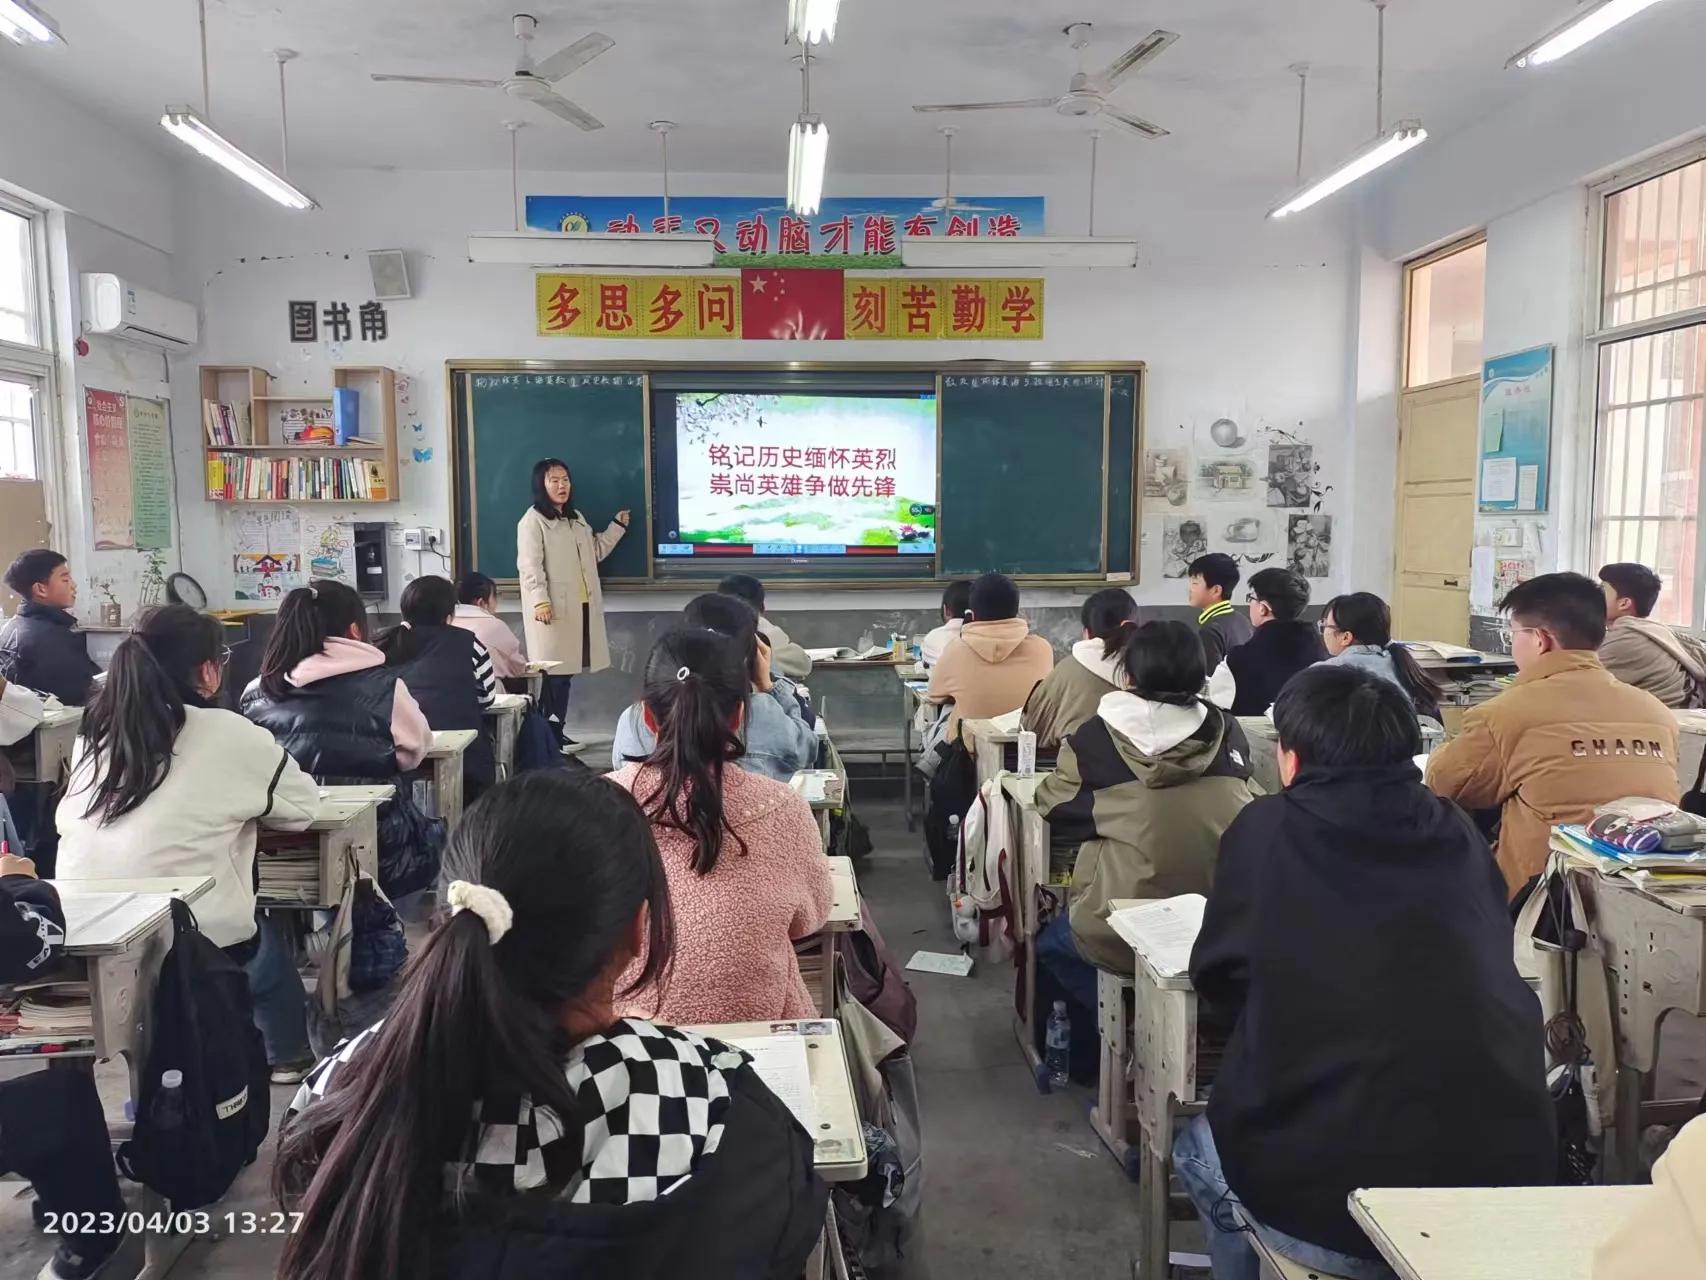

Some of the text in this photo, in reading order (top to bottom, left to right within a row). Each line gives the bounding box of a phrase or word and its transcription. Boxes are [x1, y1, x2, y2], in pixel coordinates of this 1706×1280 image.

[288, 300, 387, 343] 图书角
[545, 281, 1036, 333] 多思多问 刻苦勤学
[708, 444, 897, 471] 铭记历史缅怀英烈
[709, 472, 897, 498] 崇尚英雄争做先锋
